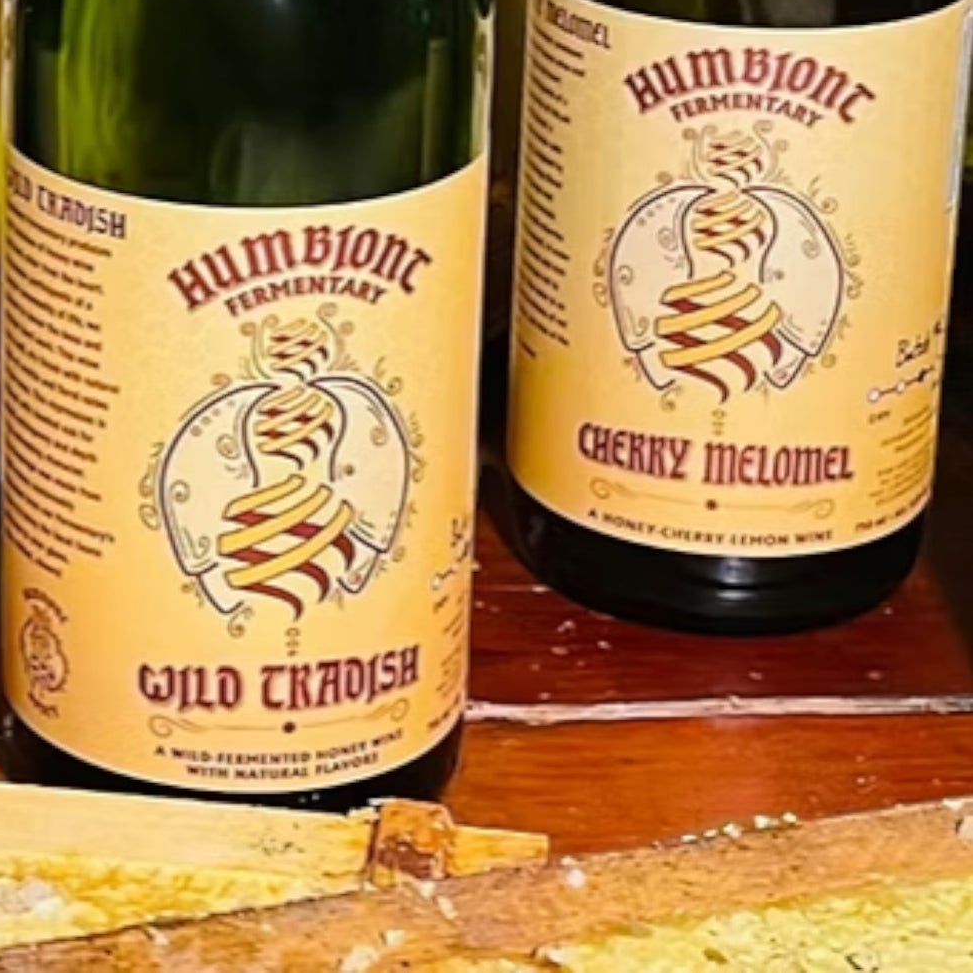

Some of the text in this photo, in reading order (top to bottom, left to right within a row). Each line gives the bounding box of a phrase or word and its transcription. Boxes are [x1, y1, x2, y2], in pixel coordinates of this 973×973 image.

[670, 93, 823, 128] FERMENTARY
[224, 276, 388, 317] FERMENTARY
[577, 421, 692, 480] CHERRY
[701, 440, 854, 487] MELOMEL
[587, 508, 598, 519] A
[730, 531, 789, 547] LEMON
[794, 529, 834, 544] WINE
[138, 662, 243, 712] WILD
[260, 644, 421, 712] TRADISH
[154, 728, 404, 765] A WILD-FERMENTED HONEY WINE
[186, 765, 228, 778] WITH
[235, 767, 308, 780] NATURAL
